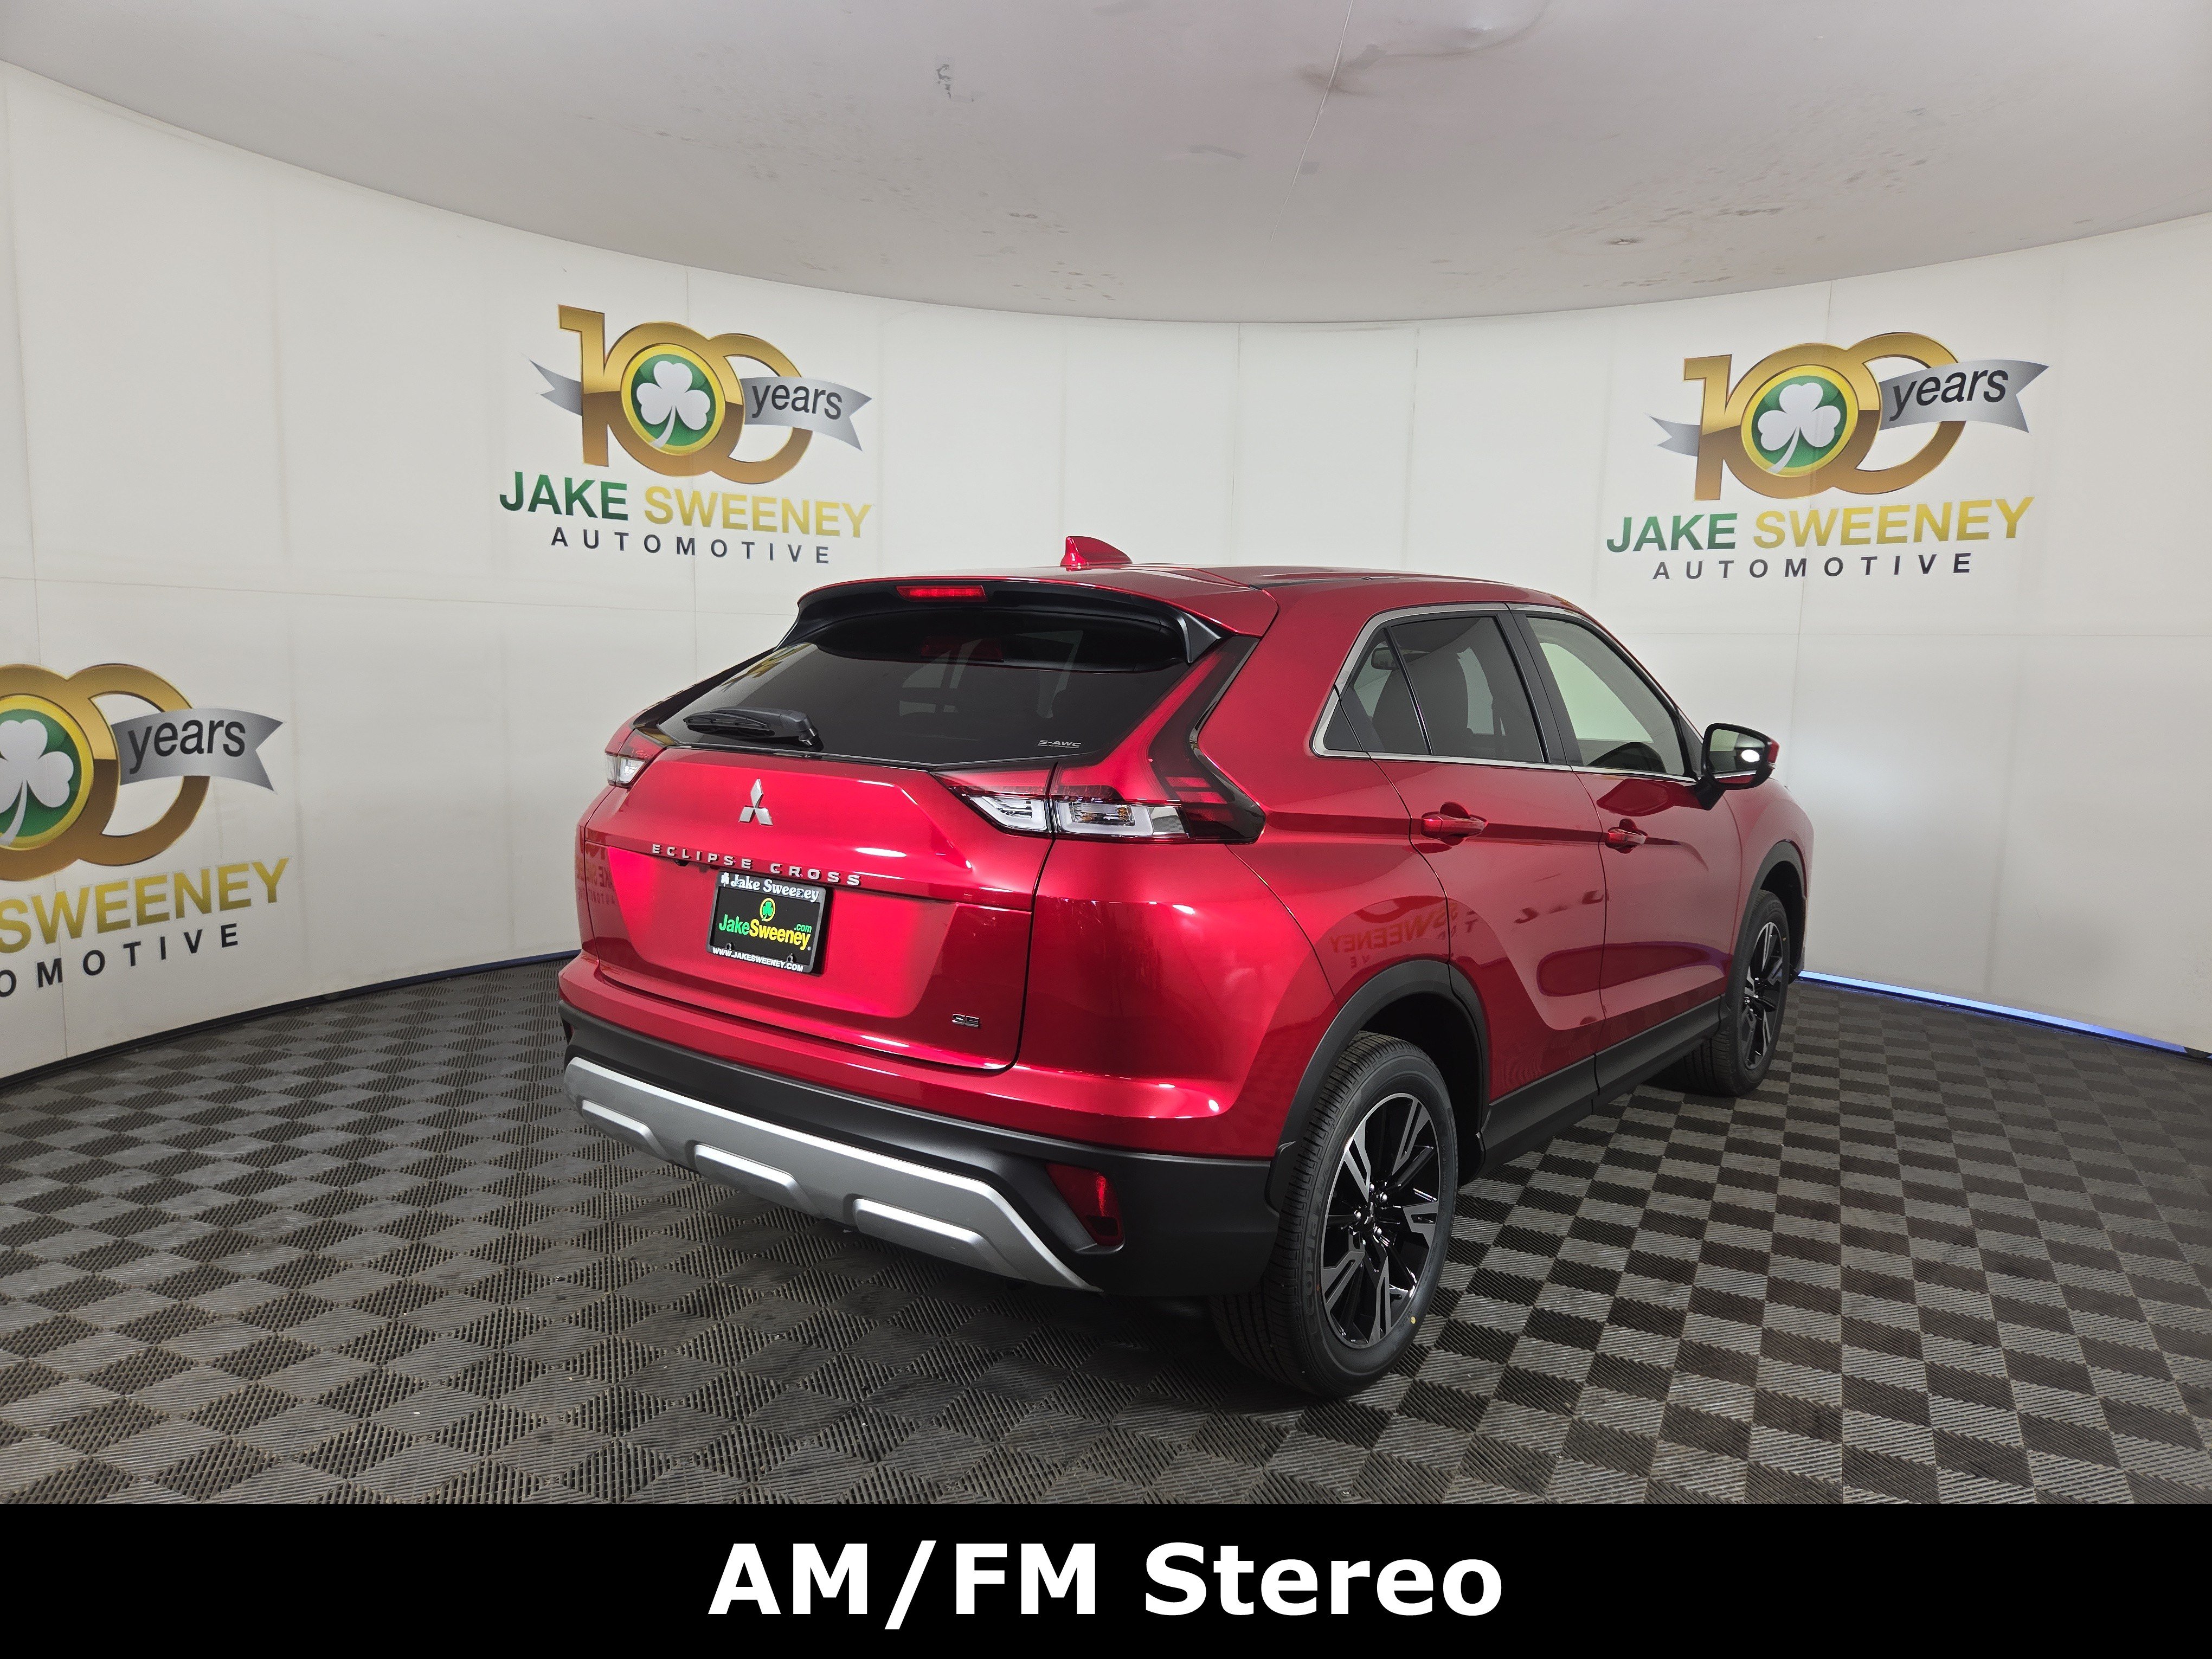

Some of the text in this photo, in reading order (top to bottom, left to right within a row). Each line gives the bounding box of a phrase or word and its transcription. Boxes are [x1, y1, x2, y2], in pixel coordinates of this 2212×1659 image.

[558, 305, 813, 484] 100
[751, 384, 843, 420] years
[1683, 332, 1968, 500] 100
[1889, 370, 2009, 421] years
[499, 471, 872, 538] JAKE SWEENEY
[1606, 496, 2035, 553] JAKE SWEENEY
[551, 527, 829, 564] AUTOMOTIVE
[1652, 552, 1972, 580] AUTOMOTIVE
[127, 719, 246, 774] years
[0, 663, 211, 882] 00
[652, 844, 860, 886] ECLIPSE CROSS
[730, 873, 819, 902] Jake Sweeney
[0, 857, 290, 954] SWEENEY
[794, 923, 812, 933] .com
[0, 923, 238, 997] OMOTIVE
[712, 947, 803, 972] WWW.JAKESWEENEY.COM
[951, 1013, 979, 1028] SE
